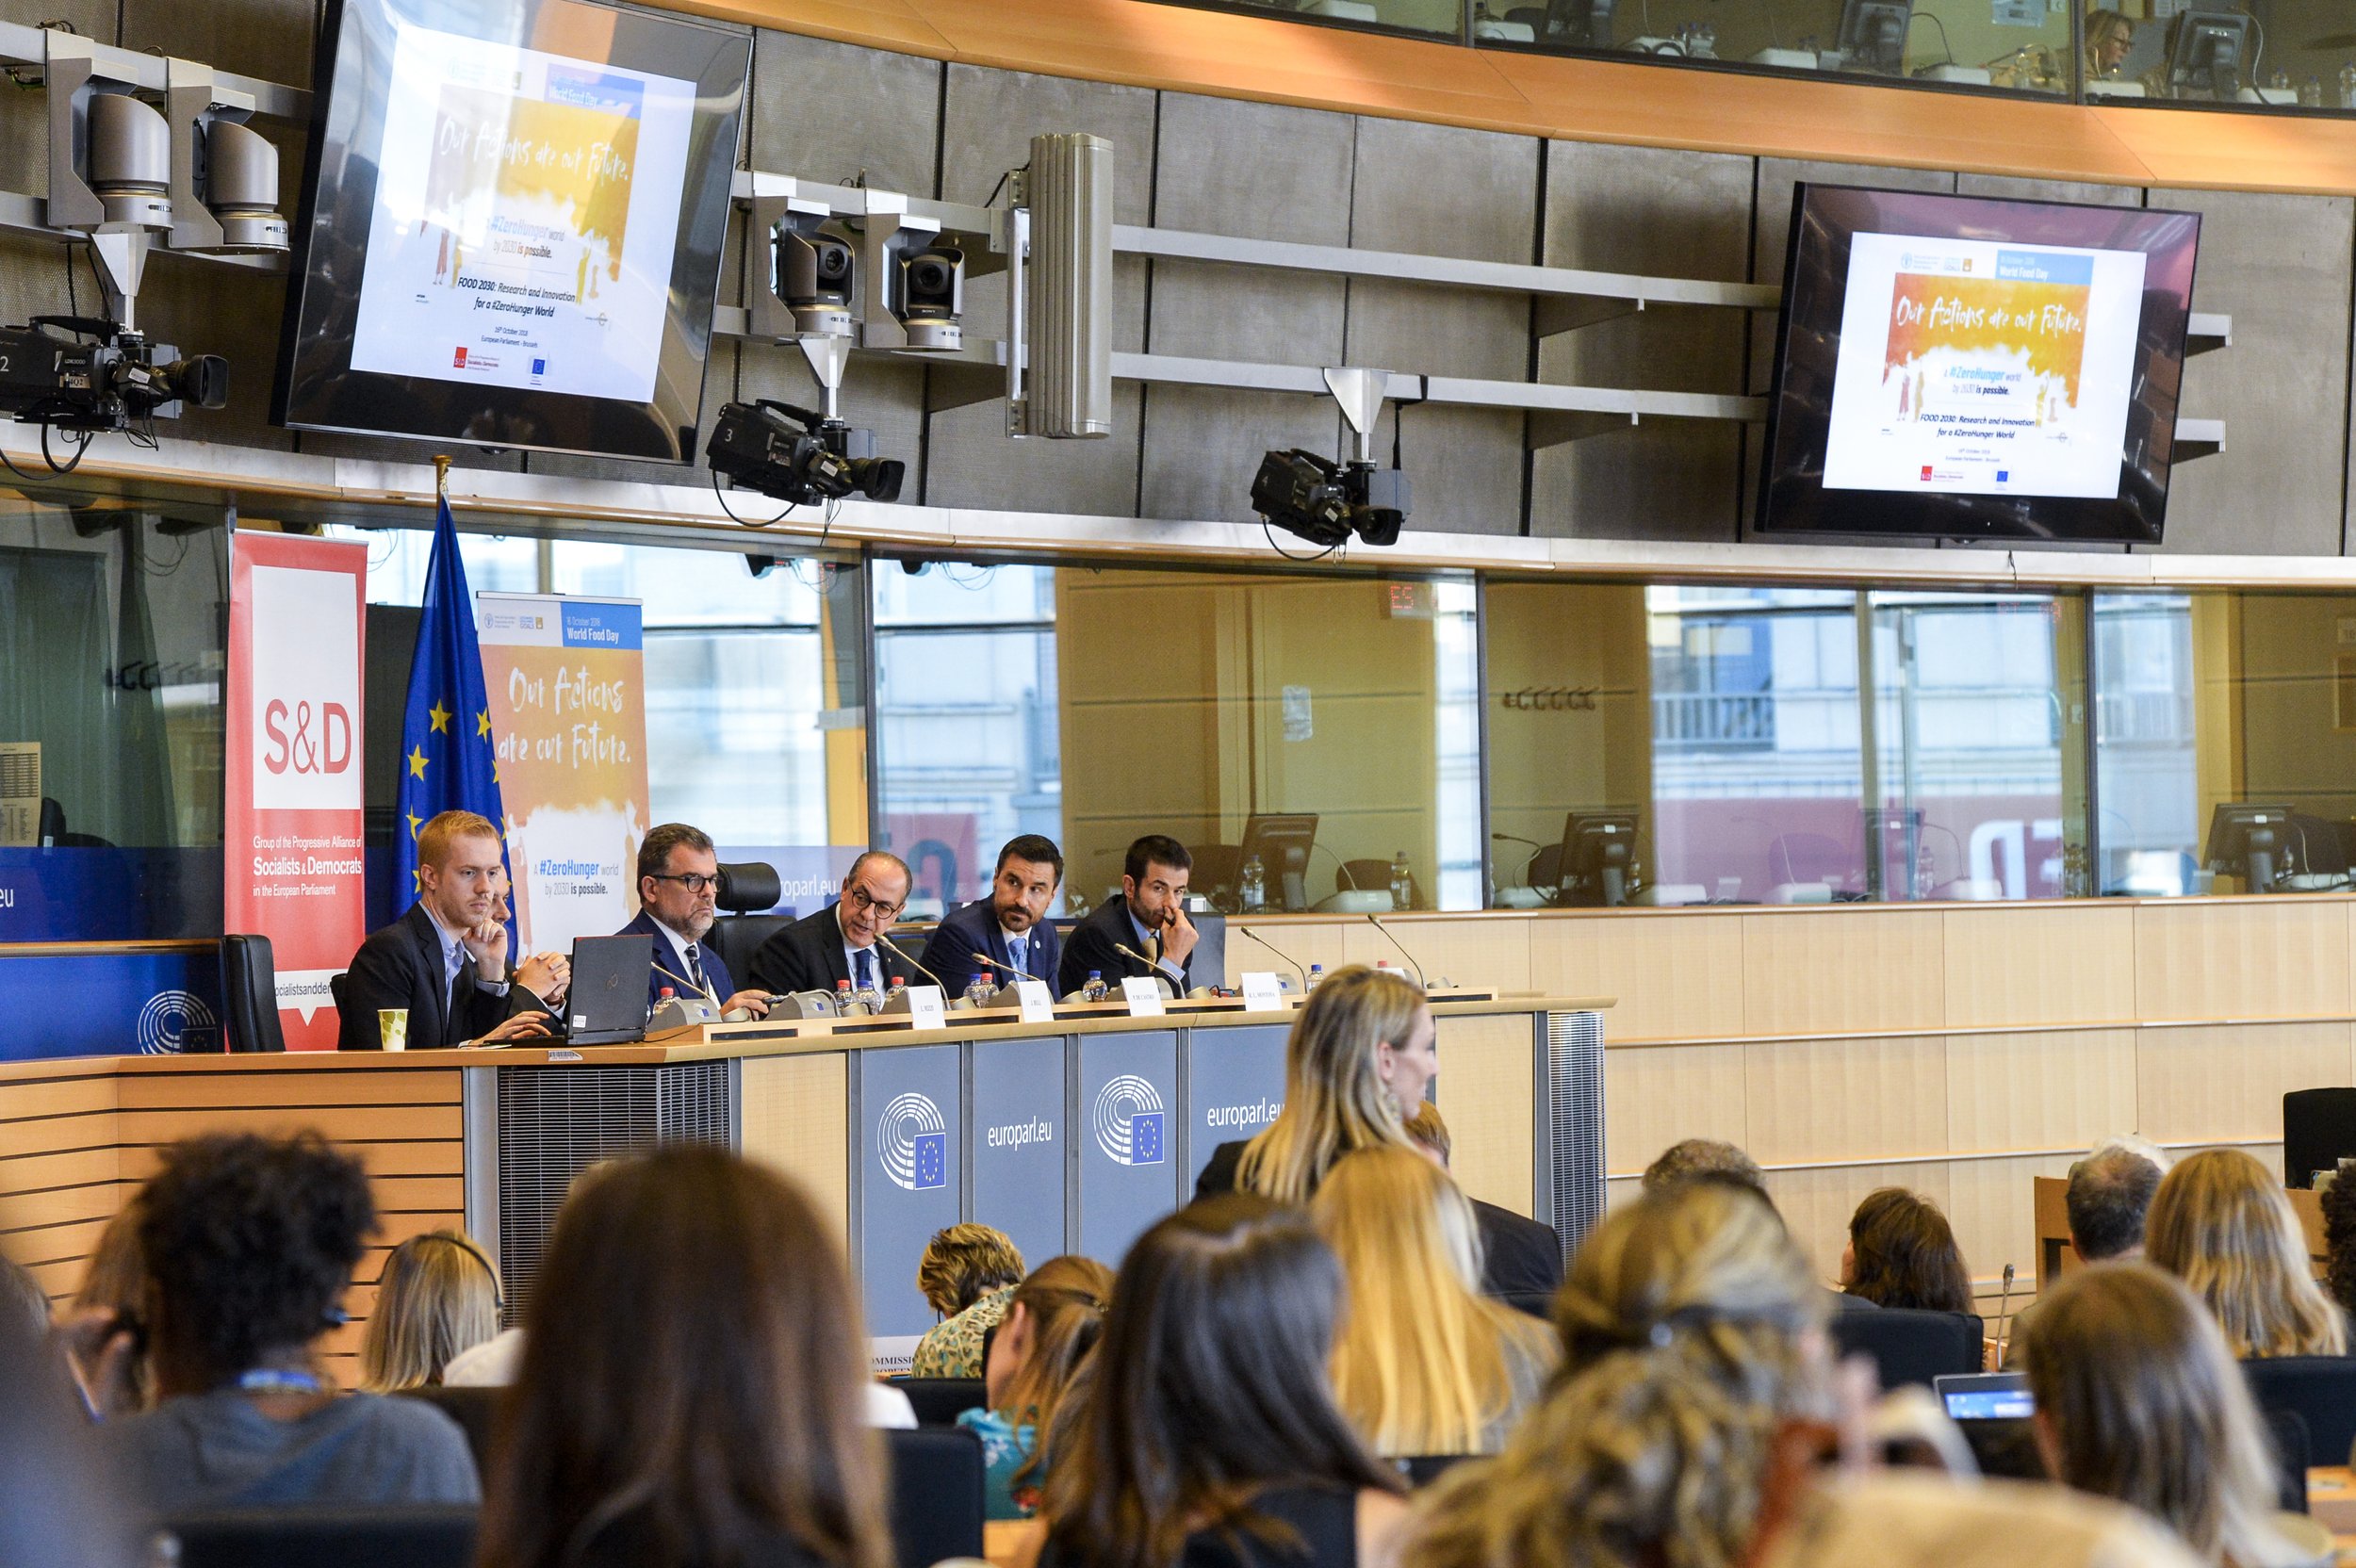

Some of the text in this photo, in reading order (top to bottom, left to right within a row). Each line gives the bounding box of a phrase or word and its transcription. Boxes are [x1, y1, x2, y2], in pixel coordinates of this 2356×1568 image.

[440, 115, 469, 155] Our
[535, 141, 557, 170] are
[561, 146, 582, 175] our
[587, 141, 630, 187] Future.
[517, 241, 522, 254] is
[524, 245, 552, 259] possible.
[458, 277, 575, 302] FOOD 2030: Research and Innovation
[474, 297, 484, 310] for
[492, 300, 533, 317] #ZeroHunger
[535, 305, 554, 318] World
[1896, 295, 2082, 339] Our Actions are our Future.
[0, 356, 9, 372] 2
[1949, 366, 2005, 384] #ZeroHunger
[1975, 384, 1981, 394] is
[1983, 384, 2010, 396] possible.
[1939, 415, 1957, 423] 2030:
[1959, 416, 1988, 424] Research
[1988, 416, 2000, 425] and
[2002, 417, 2036, 426] Innovation
[725, 429, 733, 443] 3
[1938, 428, 1947, 437] for
[567, 628, 619, 645] World Food Day
[509, 665, 625, 716] Our Actions
[264, 698, 352, 775] S&D
[499, 720, 631, 770] are our Future.
[253, 835, 275, 852] Group
[276, 836, 283, 848] of
[283, 836, 292, 848] the
[292, 835, 331, 852] Progressive
[332, 835, 356, 848] Alliance
[253, 856, 362, 876] Socialists & Democrats
[540, 859, 599, 880] #ZeroHunger
[601, 863, 618, 876] world
[253, 884, 335, 899] in the European Parliament
[545, 883, 609, 898] by 2030 is possible.
[780, 874, 837, 903] roparl.eu
[275, 981, 333, 997] ocialistsandde
[988, 1116, 1052, 1152] europarl.eu
